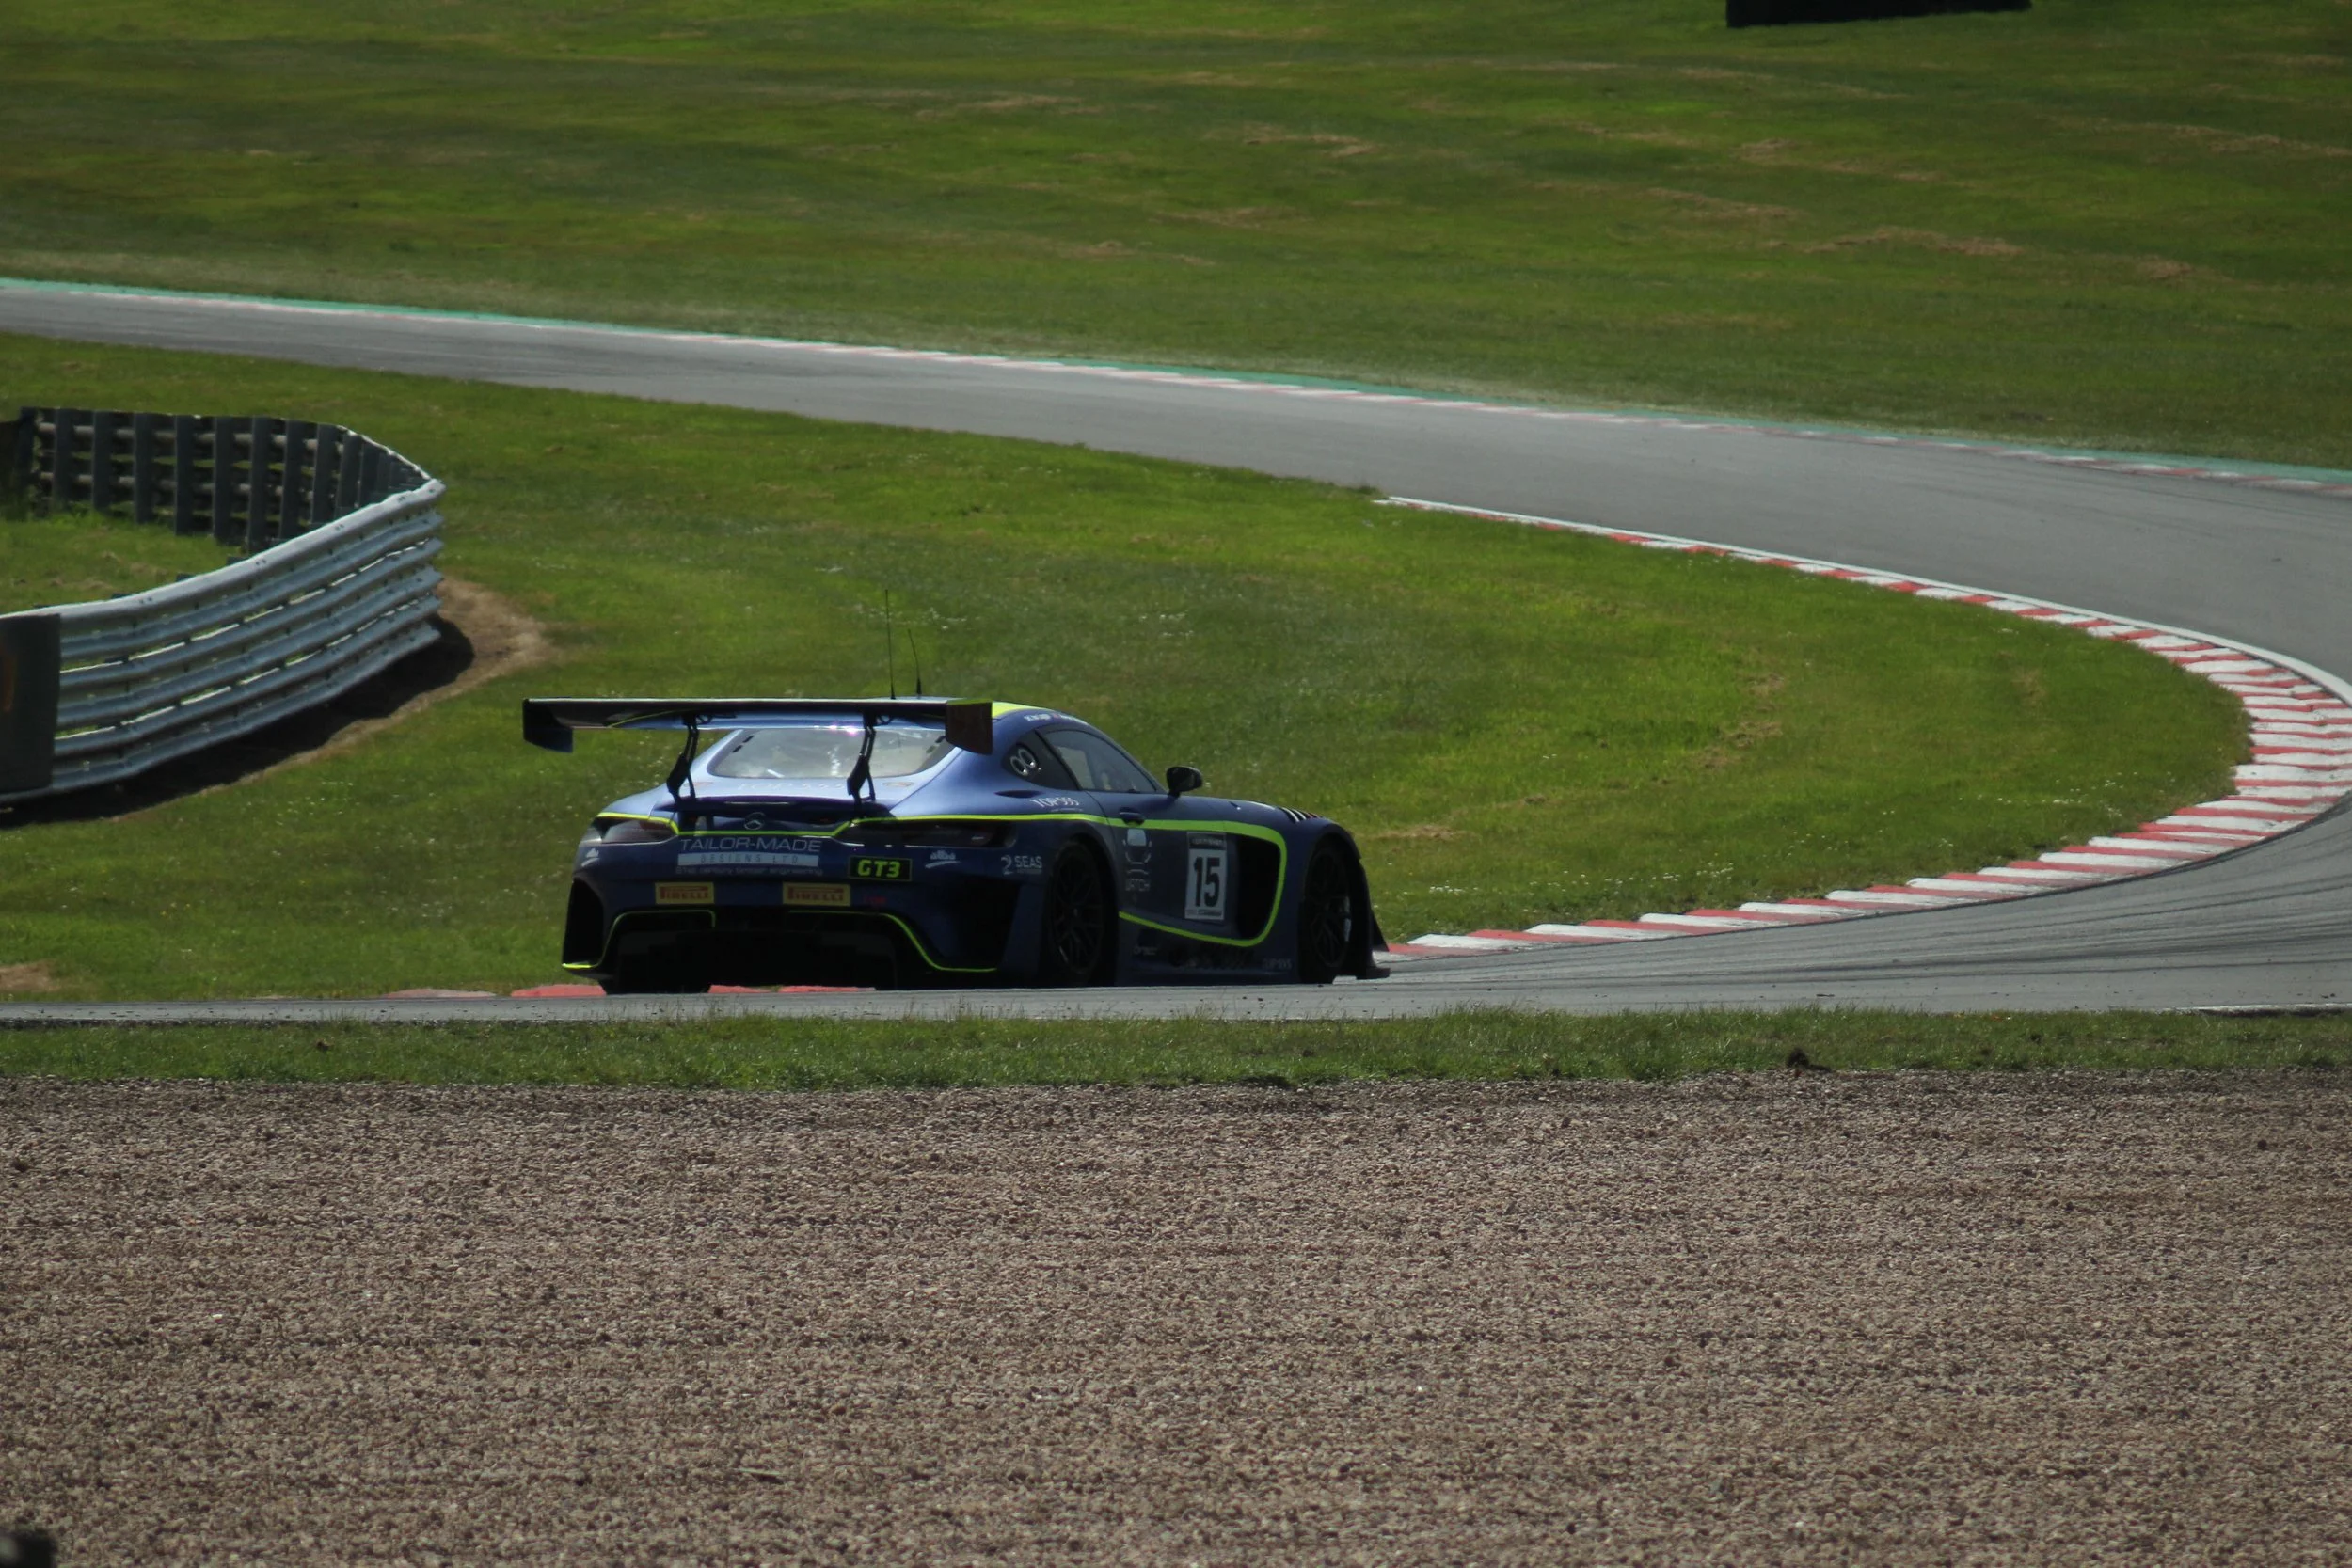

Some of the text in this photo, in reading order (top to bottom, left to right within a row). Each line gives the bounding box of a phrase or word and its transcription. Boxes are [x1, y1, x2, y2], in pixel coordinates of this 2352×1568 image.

[679, 836, 823, 853] TAILOR-MADE
[700, 853, 799, 864] DESIGNS LTD
[1001, 855, 1042, 875] 2 SEAS
[858, 859, 900, 878] GT3
[1194, 857, 1220, 907] 15
[660, 886, 708, 899] PIRELLI
[787, 887, 844, 901] PIRELLI
